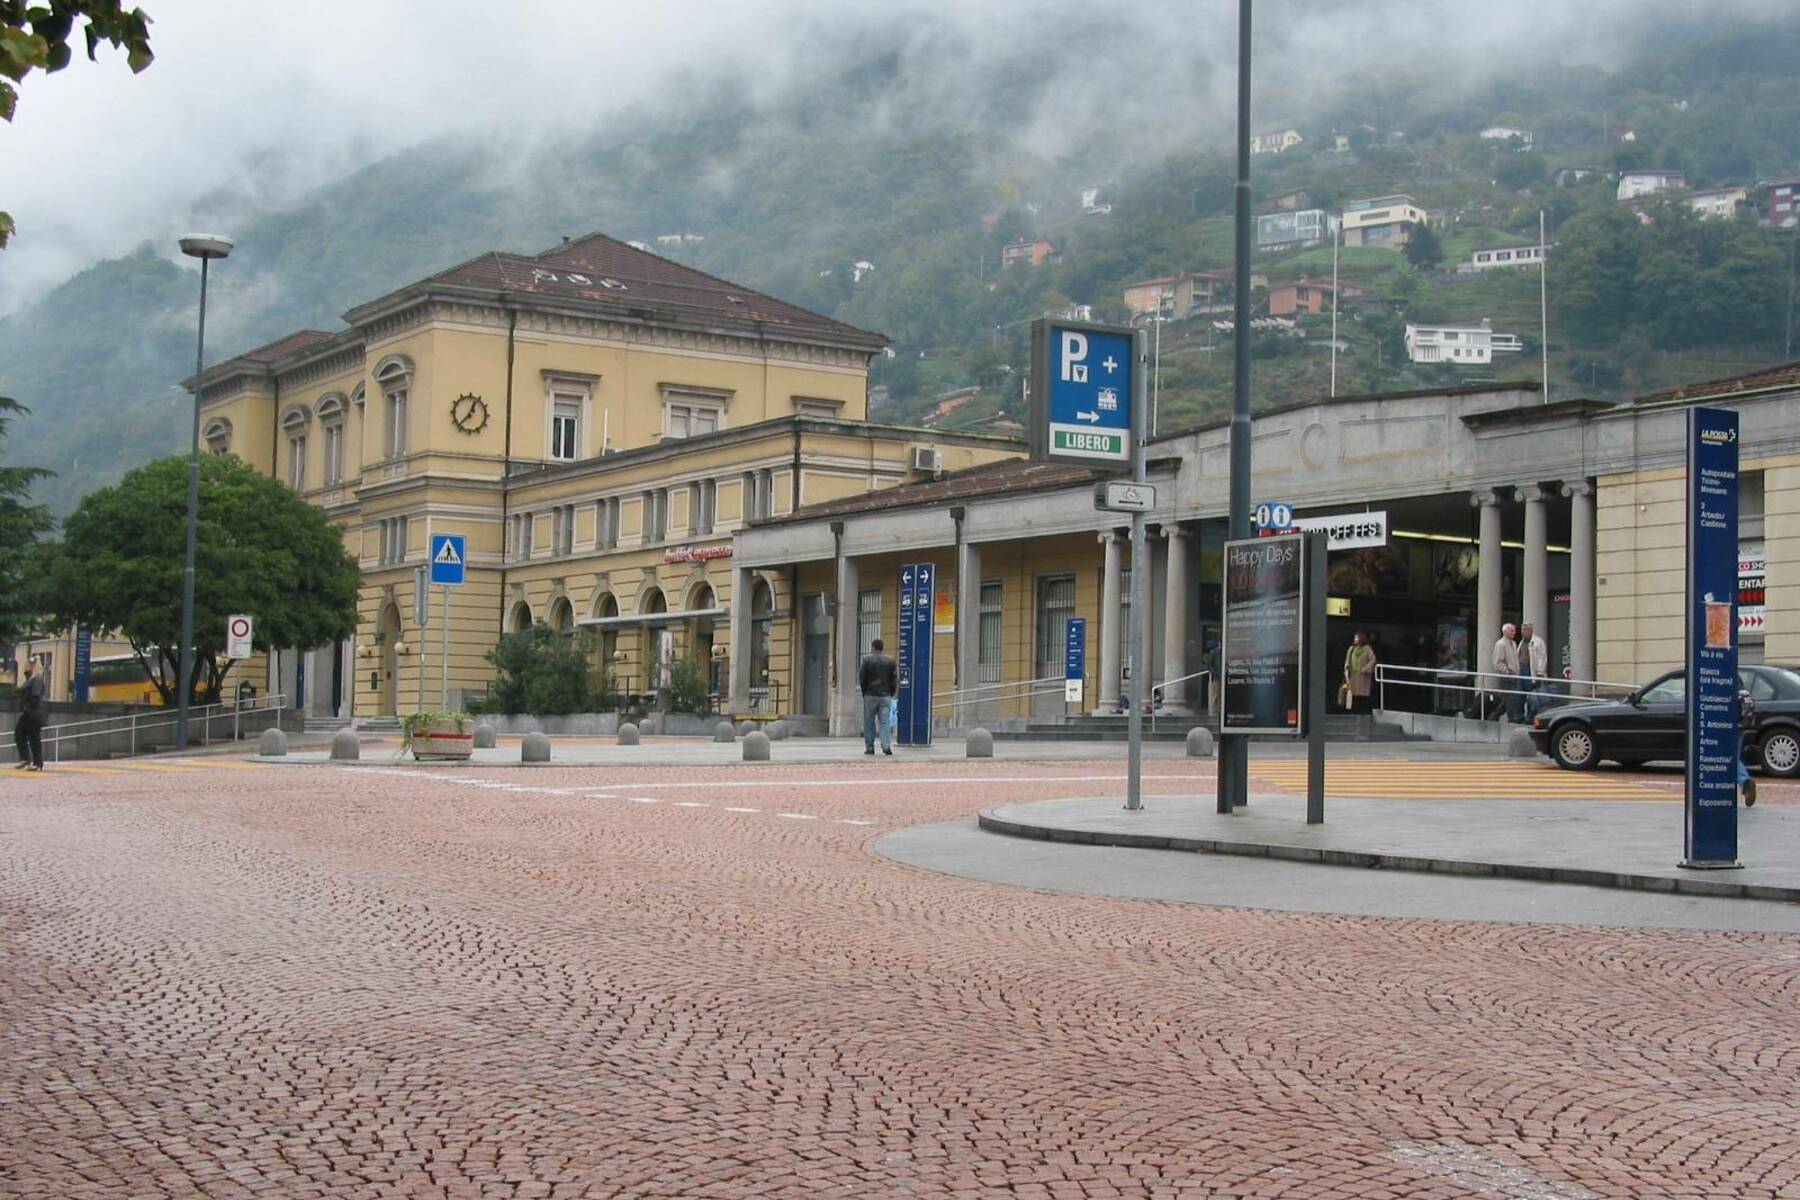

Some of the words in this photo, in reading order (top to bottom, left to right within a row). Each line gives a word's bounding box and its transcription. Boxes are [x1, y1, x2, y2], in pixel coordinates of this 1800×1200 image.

[1061, 331, 1088, 381] P
[1065, 433, 1110, 451] LIBERO
[1701, 468, 1735, 479] Autopostale
[1328, 525, 1351, 540] CFF
[1354, 522, 1377, 537] FFS
[1230, 547, 1264, 568] Happy
[1266, 545, 1294, 565] Days
